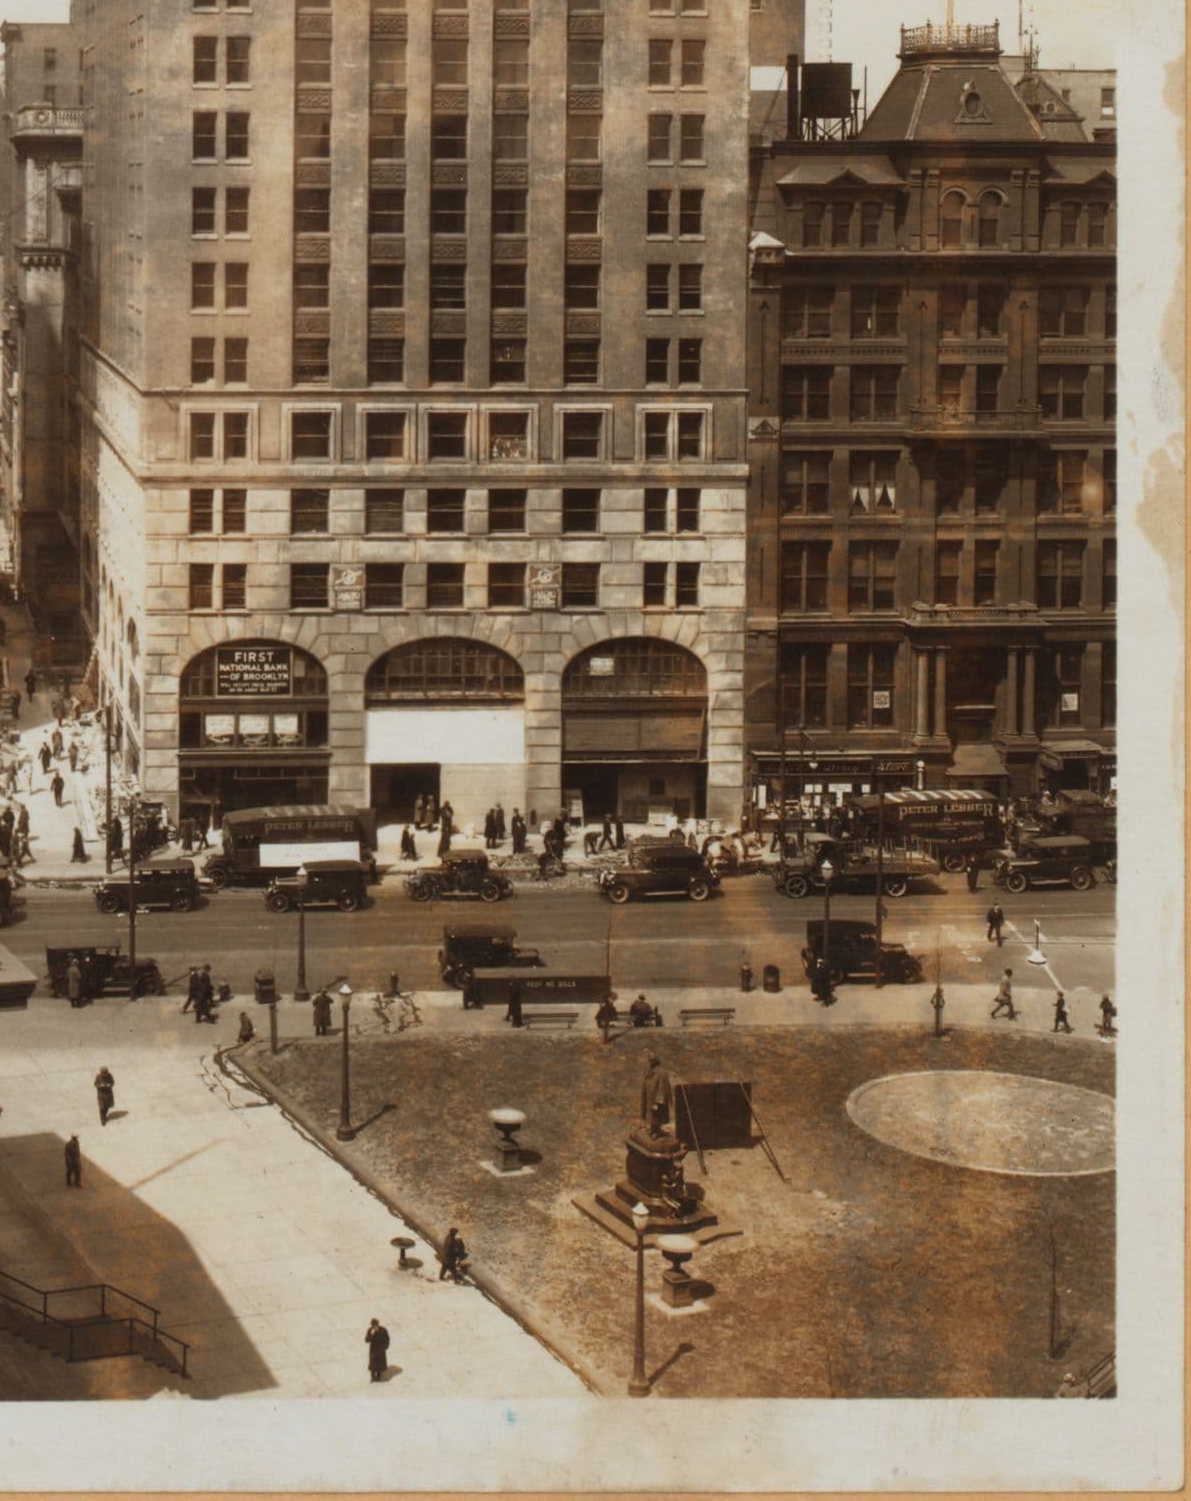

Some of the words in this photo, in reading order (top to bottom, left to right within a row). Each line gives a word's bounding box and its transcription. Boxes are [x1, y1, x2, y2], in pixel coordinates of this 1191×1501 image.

[234, 651, 274, 662] FIRST
[219, 663, 261, 672] NATIONAL
[264, 663, 288, 672] BANK
[229, 673, 240, 681] OF
[243, 673, 289, 681] BROOKLYN
[899, 805, 938, 820] PETER
